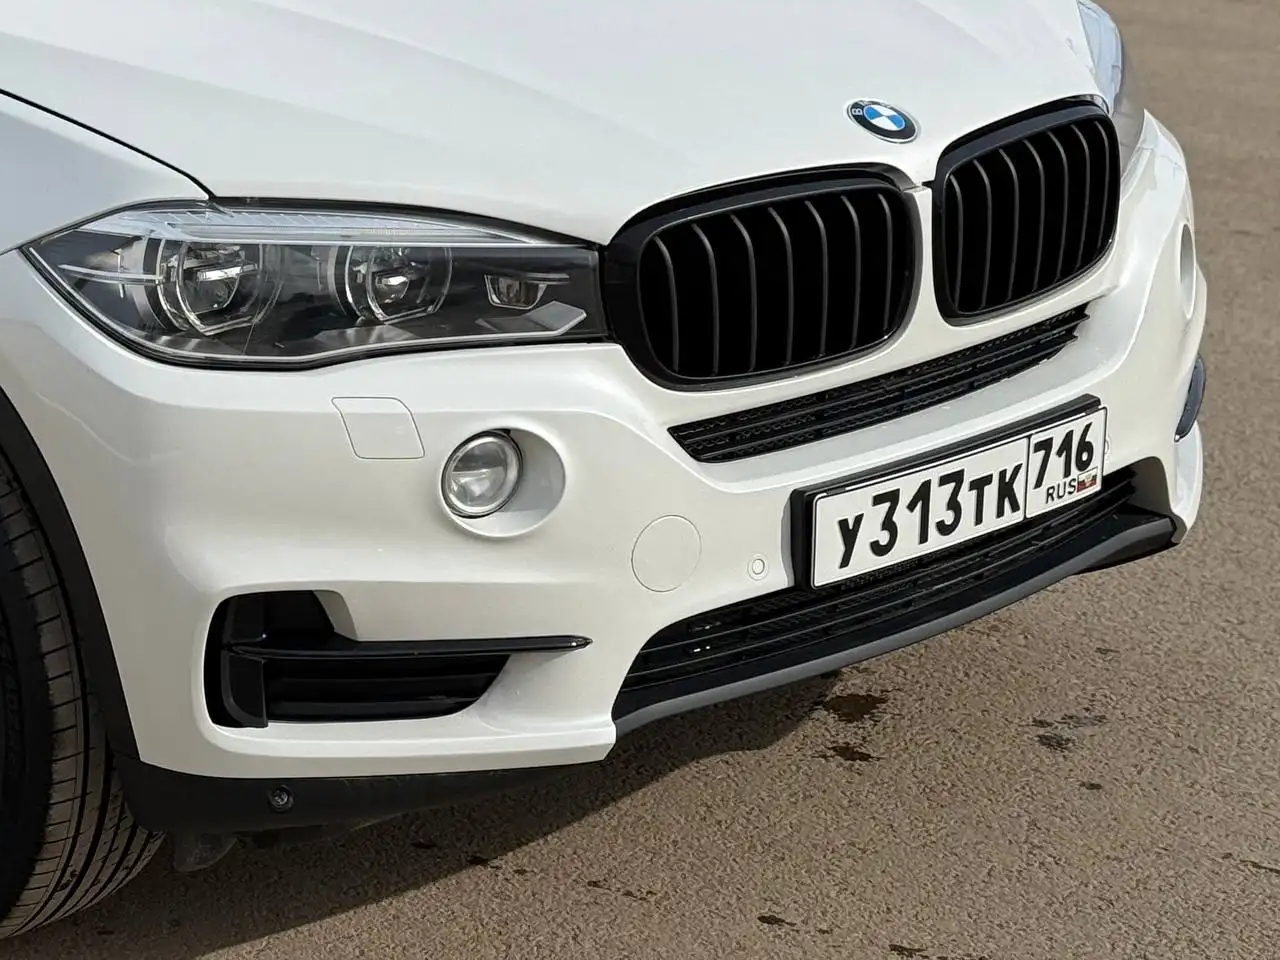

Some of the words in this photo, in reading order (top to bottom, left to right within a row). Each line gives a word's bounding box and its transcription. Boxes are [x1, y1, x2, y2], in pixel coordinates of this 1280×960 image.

[838, 464, 1023, 569] У313ТК
[1033, 423, 1094, 490] 716
[1045, 478, 1077, 504] RUS
